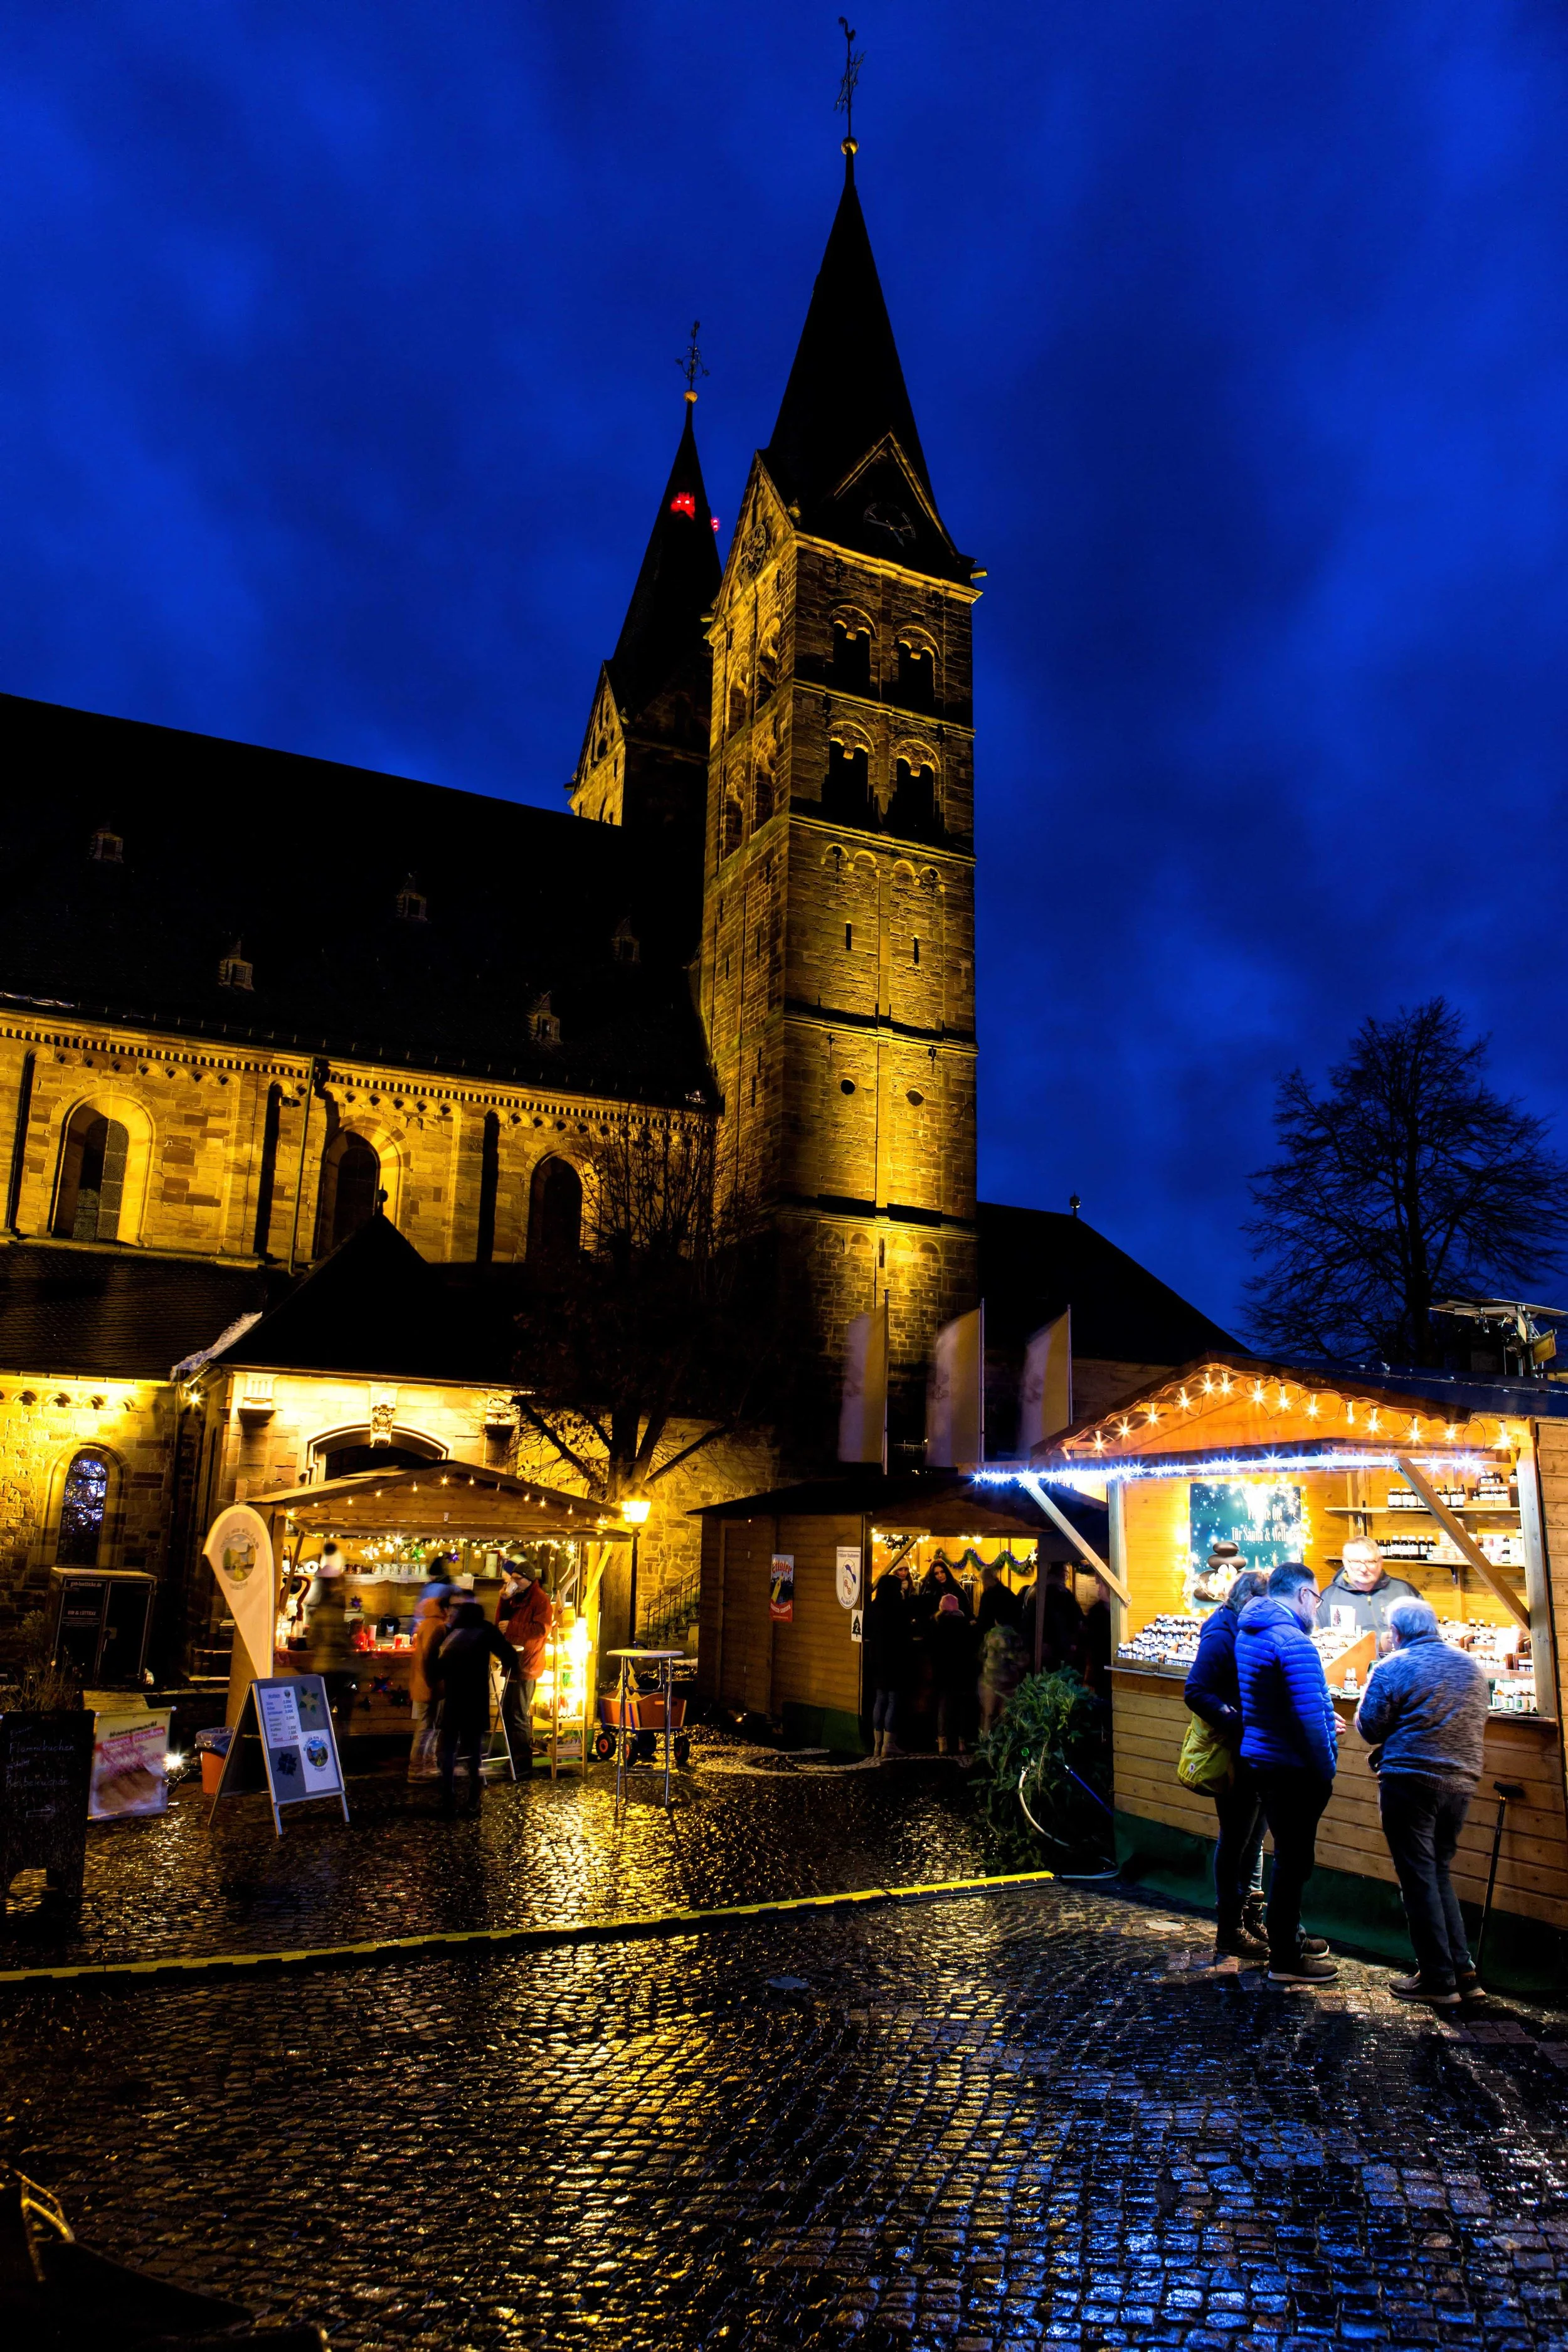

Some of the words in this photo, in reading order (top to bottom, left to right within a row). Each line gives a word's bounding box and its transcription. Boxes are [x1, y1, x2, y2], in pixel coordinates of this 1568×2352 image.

[1248, 1506, 1271, 1520] Fete
[1231, 1527, 1242, 1541] für
[1243, 1527, 1264, 1542] Sauna
[1264, 1527, 1271, 1541] &
[855, 1623, 859, 1633] 2
